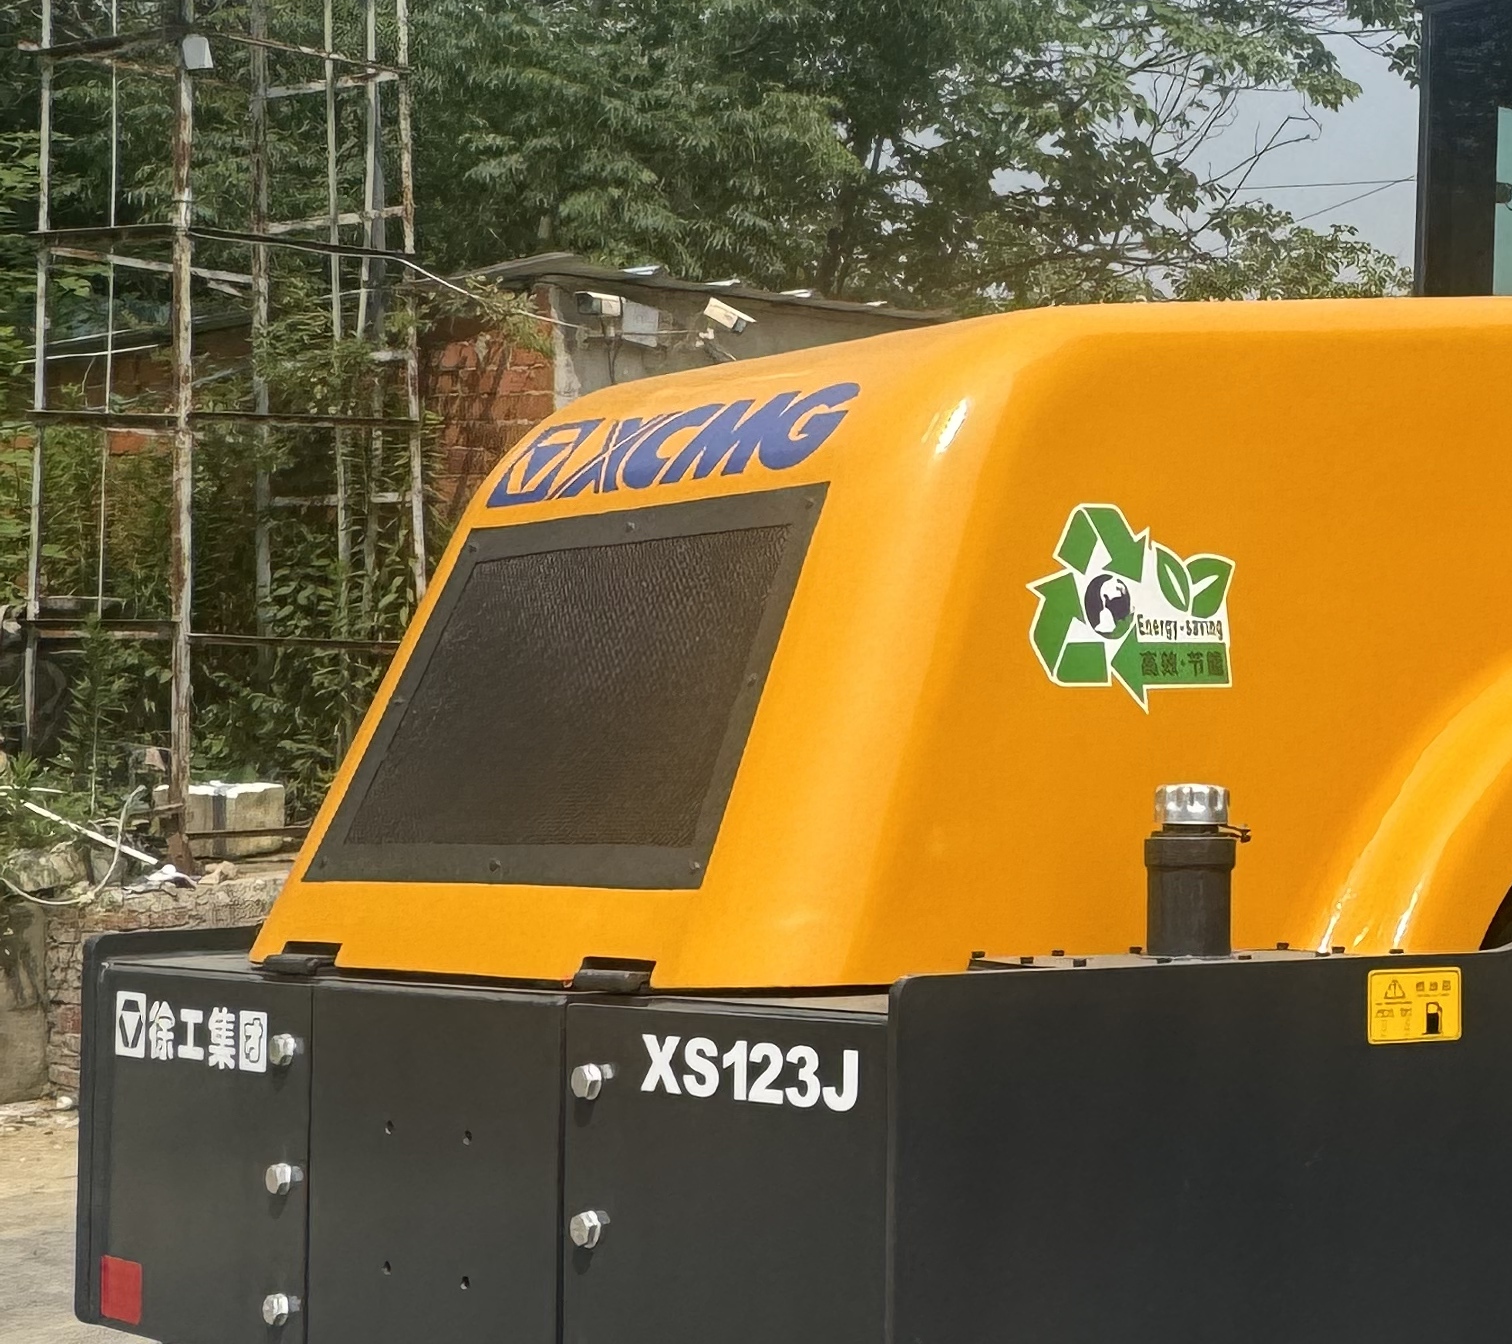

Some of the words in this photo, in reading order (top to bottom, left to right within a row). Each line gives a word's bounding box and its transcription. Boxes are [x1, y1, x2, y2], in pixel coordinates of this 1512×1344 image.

[543, 382, 861, 500] XCMG
[148, 1000, 268, 1073] 徐工集团
[640, 1033, 860, 1113] XS123J
